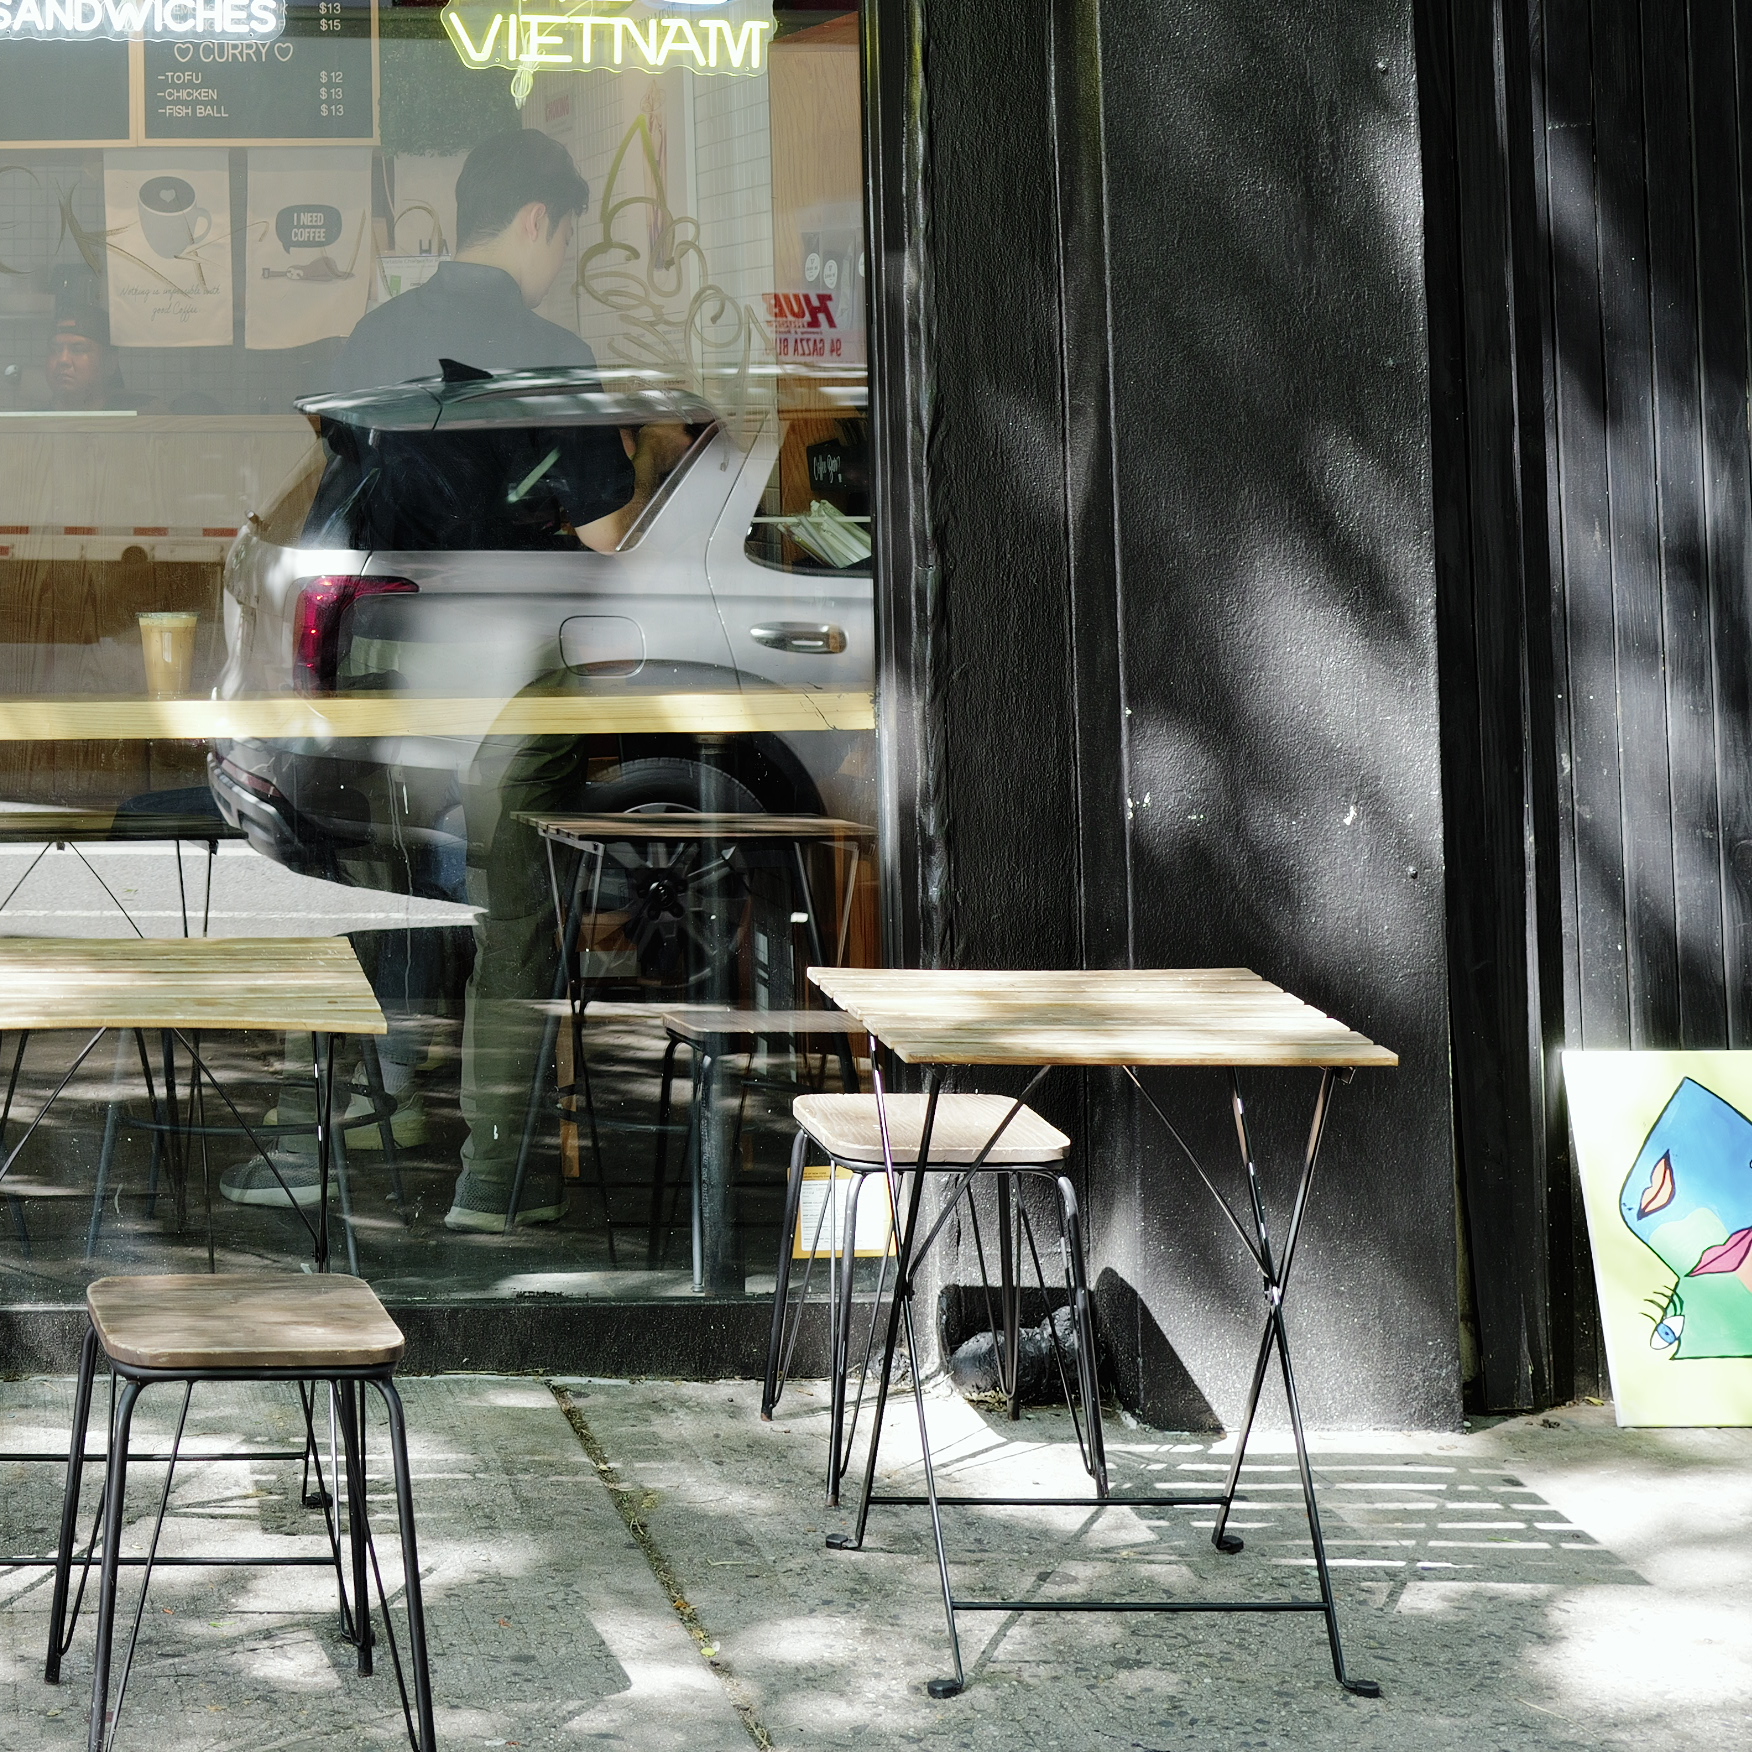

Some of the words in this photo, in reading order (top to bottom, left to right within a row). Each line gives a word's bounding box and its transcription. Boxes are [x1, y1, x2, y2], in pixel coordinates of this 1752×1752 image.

[319, 2, 341, 15] $13
[320, 18, 342, 31] $15
[450, 13, 770, 68] VIETNAM
[200, 42, 270, 62] CURRY
[197, 105, 229, 117] BALL
[299, 213, 324, 226] NEED
[291, 229, 326, 242] COFFEE
